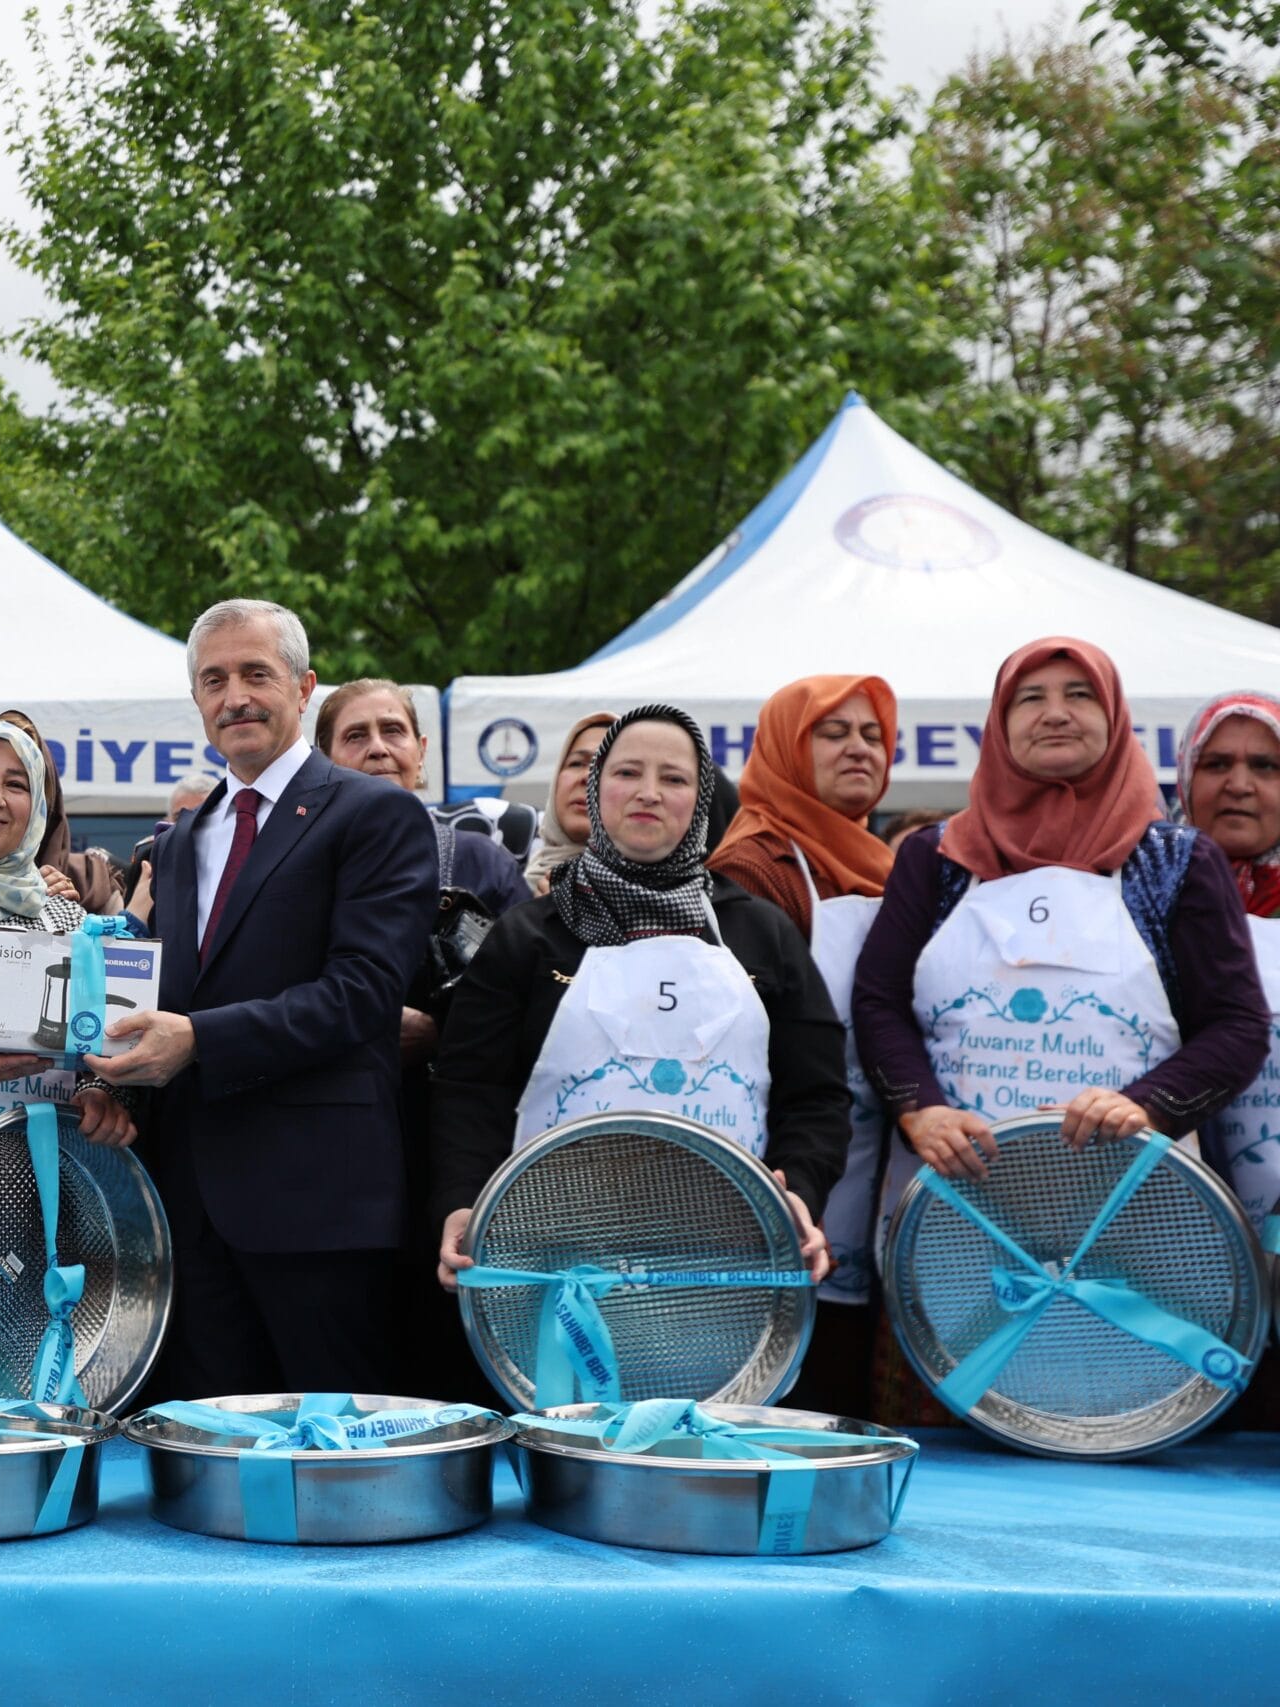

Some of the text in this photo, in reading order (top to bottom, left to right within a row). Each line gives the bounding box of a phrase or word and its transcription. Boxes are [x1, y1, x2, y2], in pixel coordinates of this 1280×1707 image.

[1028, 896, 1050, 923] 6
[657, 981, 678, 1012] 5
[958, 1027, 1105, 1057] Yuvanız Mutlu
[939, 1052, 1121, 1087] Sofranız Bereketli
